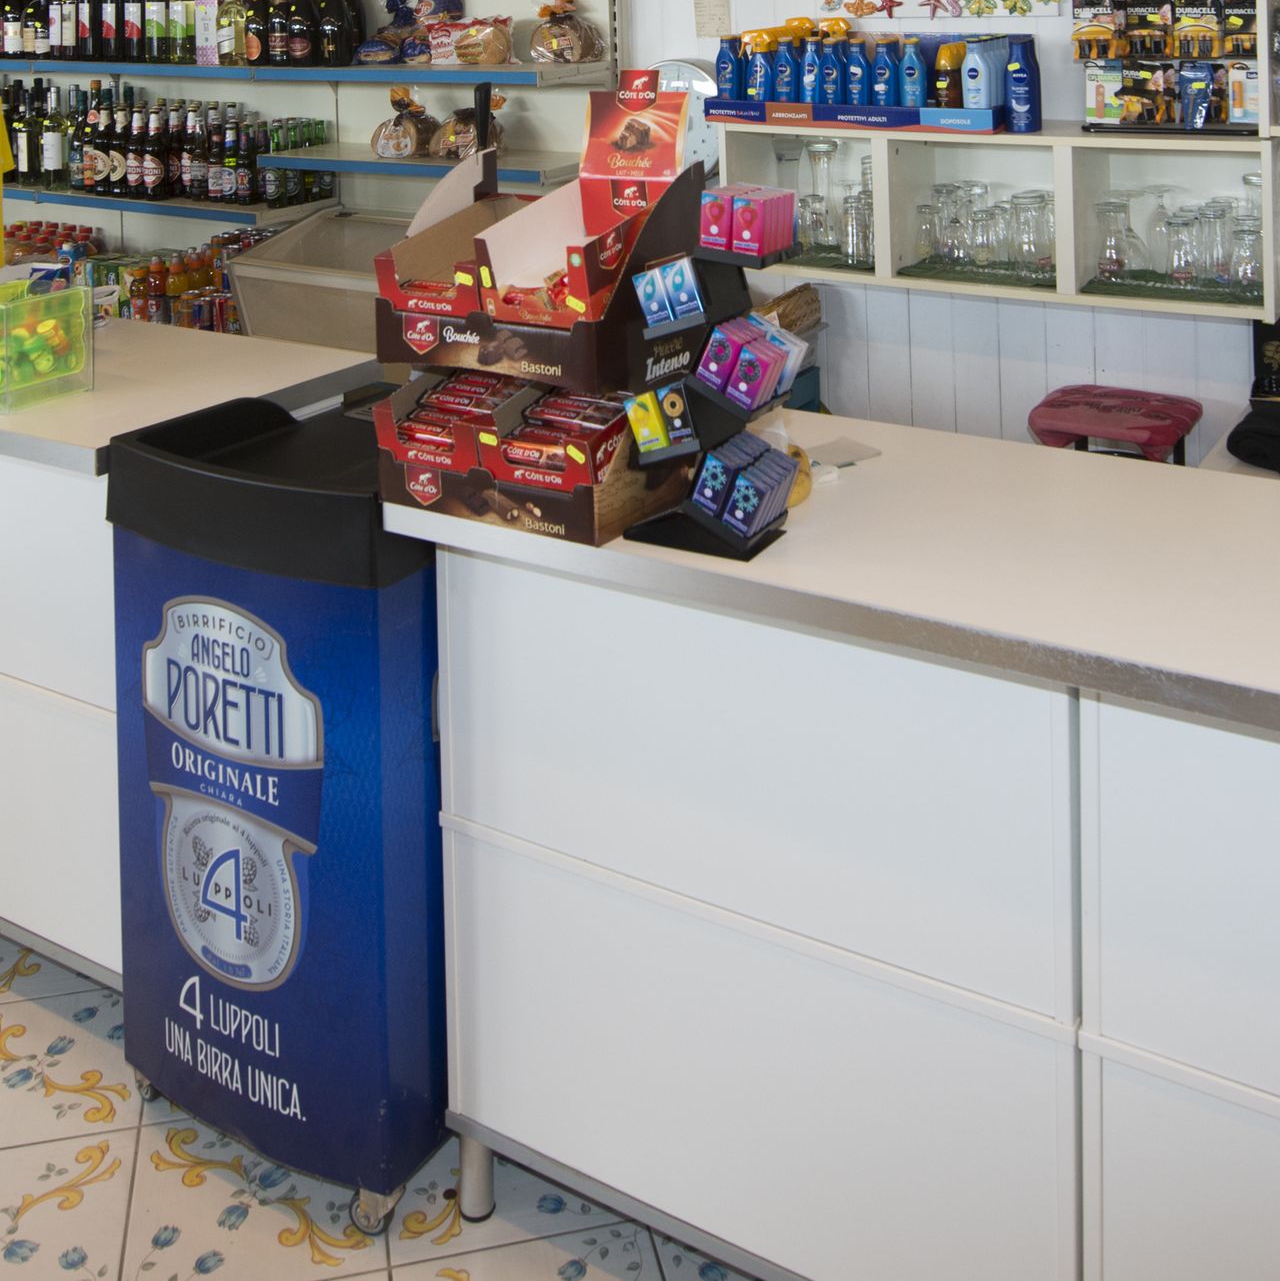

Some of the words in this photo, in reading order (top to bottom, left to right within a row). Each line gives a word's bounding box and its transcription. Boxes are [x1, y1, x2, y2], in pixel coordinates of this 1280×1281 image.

[619, 89, 638, 99] CÔTE
[639, 92, 656, 100] D'OR
[709, 109, 736, 117] PROTETTIVI
[771, 111, 808, 120] ABBRONZANTI
[838, 114, 866, 123] PROTETTIVI
[868, 116, 887, 124] ADULTI
[940, 118, 971, 126] DOPOSOLE
[608, 153, 652, 168] Bouchée
[614, 198, 630, 206] CÔTE
[443, 326, 480, 344] Bouchée
[521, 362, 562, 377] Bastoni
[646, 351, 690, 382] Intenso
[525, 518, 565, 536] Bastoni
[178, 614, 266, 652] BIRRIFICIO
[192, 633, 250, 678] ANGELO
[166, 657, 284, 759] PORETTI
[172, 742, 280, 806] ORIGINALE
[200, 783, 243, 807] CHIARA
[201, 813, 230, 826] originale
[244, 834, 268, 868] luppoli
[276, 859, 288, 882] UNA
[282, 888, 292, 930] STORIA
[269, 936, 290, 975] ITALIANA
[179, 976, 204, 1030] 4
[210, 994, 280, 1058] LUPPOLI
[165, 1017, 192, 1066] UNA
[198, 1038, 242, 1095] BIRRA
[248, 1065, 307, 1122] UNICA.
